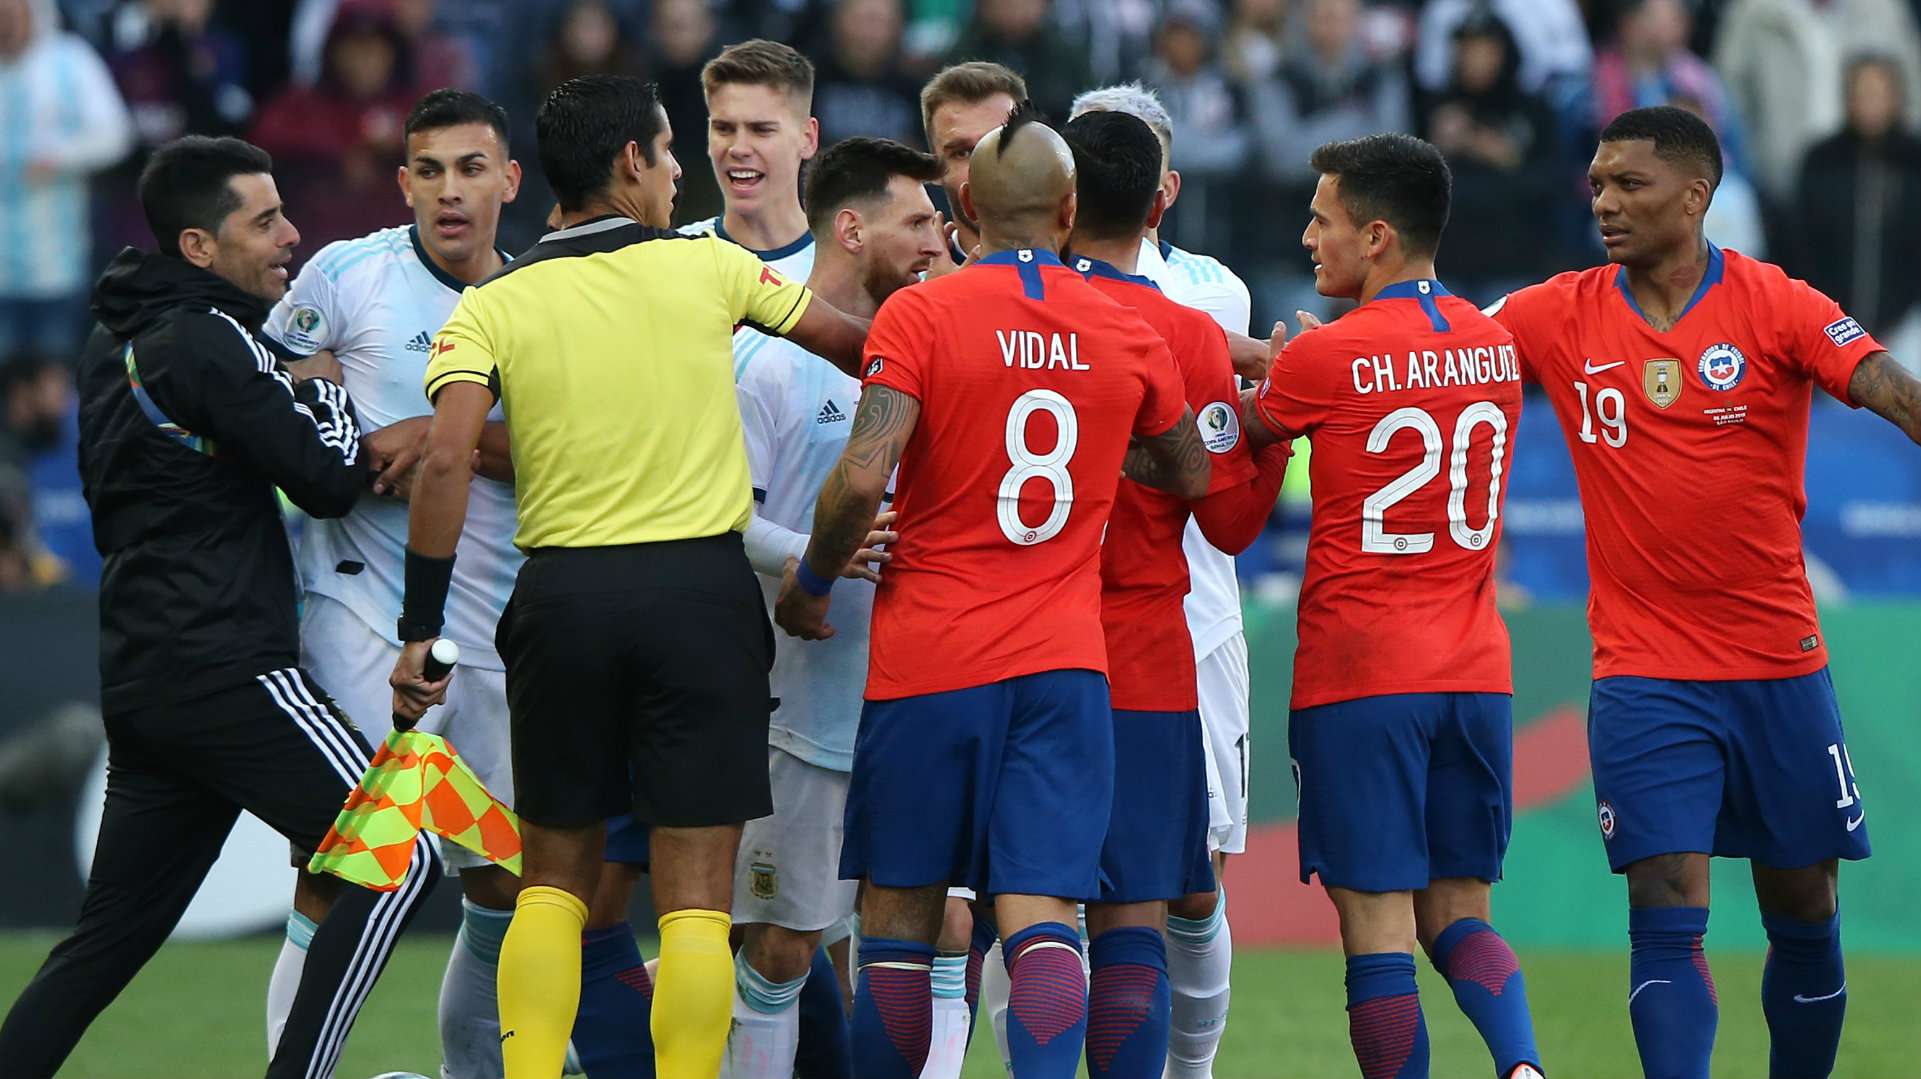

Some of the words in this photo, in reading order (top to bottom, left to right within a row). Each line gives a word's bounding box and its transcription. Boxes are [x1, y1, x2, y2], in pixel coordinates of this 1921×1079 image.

[995, 329, 1091, 371] VIDAL
[996, 388, 1079, 546] 8
[1574, 381, 1628, 449] 19
[1361, 401, 1508, 554] 20
